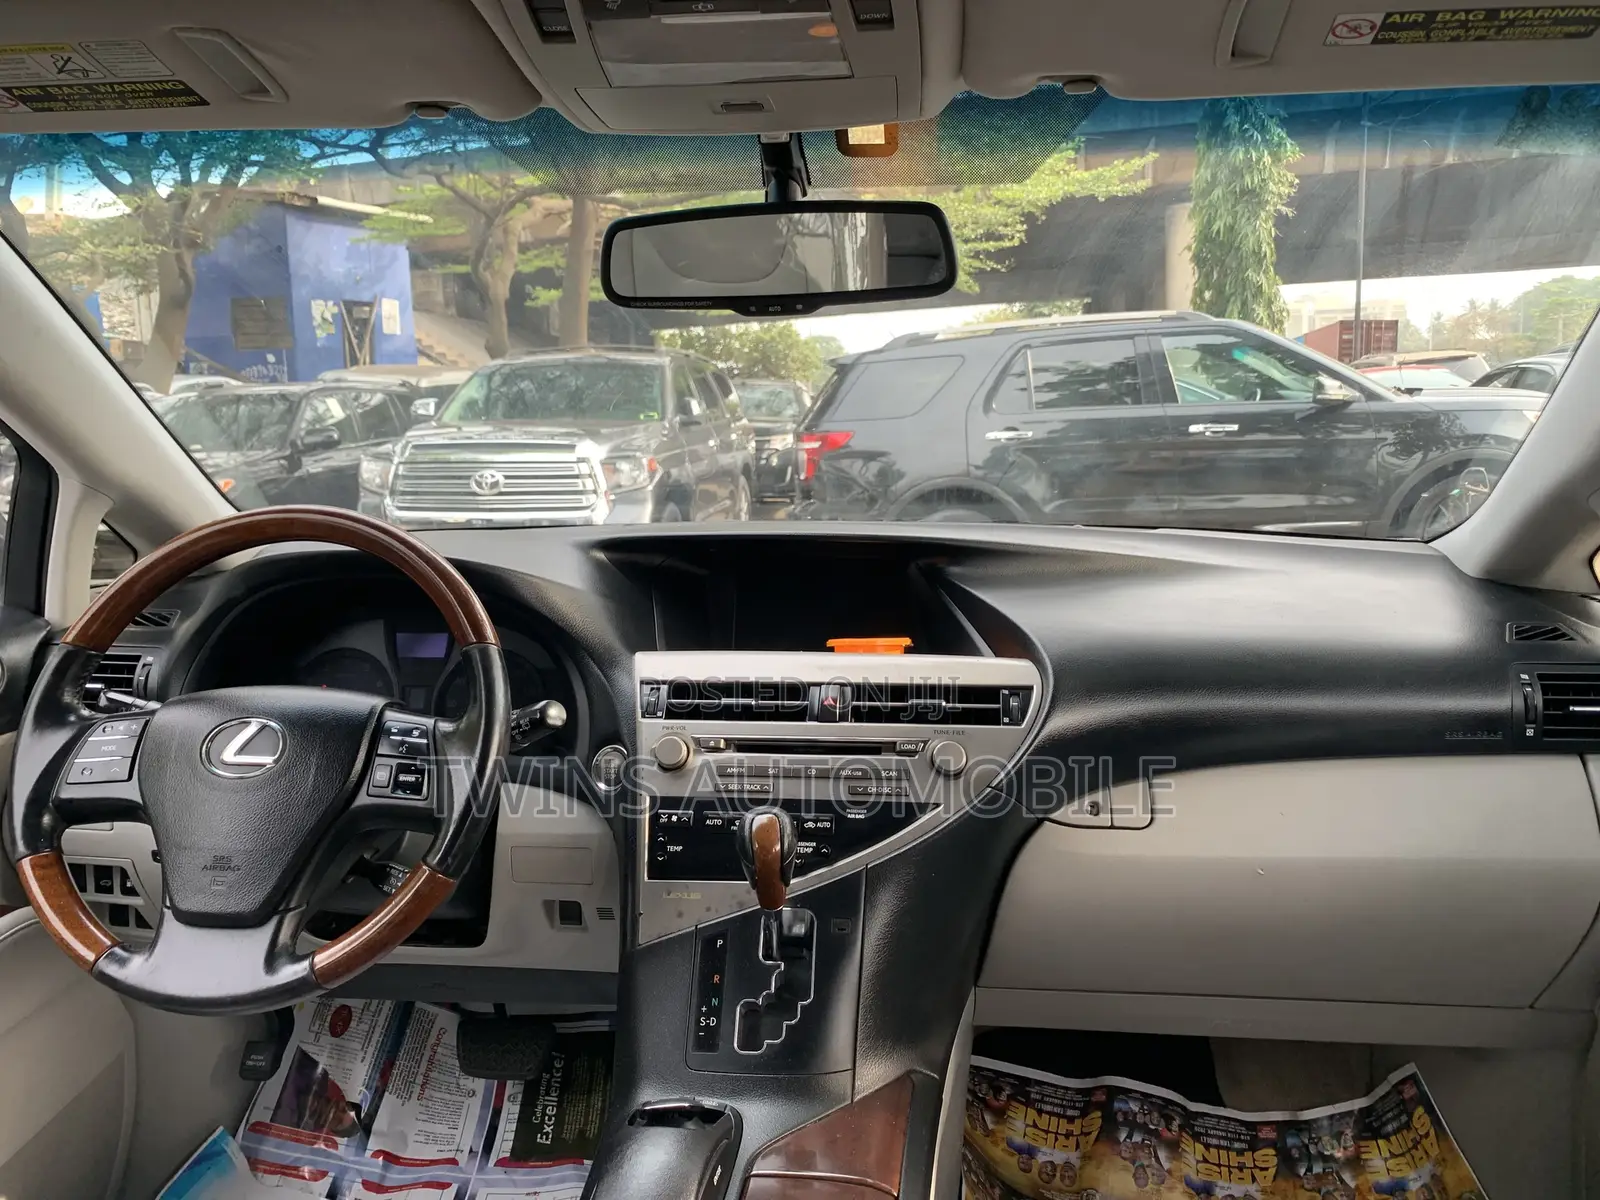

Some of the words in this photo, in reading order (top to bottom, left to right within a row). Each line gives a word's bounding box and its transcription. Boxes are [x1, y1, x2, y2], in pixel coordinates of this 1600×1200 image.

[1386, 12, 1426, 23] AIR
[1436, 10, 1487, 21] BAG
[12, 86, 43, 96] AIR
[48, 85, 86, 95] BAG
[93, 81, 186, 93] WARNING
[201, 864, 241, 872] AIRBAG
[716, 939, 723, 949] P
[713, 974, 720, 984] R
[711, 997, 719, 1006] N
[416, 1026, 448, 1102] Congratulations
[532, 1072, 551, 1123] Celebrating
[537, 1051, 565, 1145] Excellence!
[1004, 1100, 1102, 1136] SHINE
[1005, 1118, 1100, 1153] ARISE
[1360, 1105, 1431, 1159] SHINE
[1179, 1131, 1277, 1168] SHINE
[1364, 1127, 1440, 1181] ARISE
[1181, 1153, 1277, 1187] ARISE
